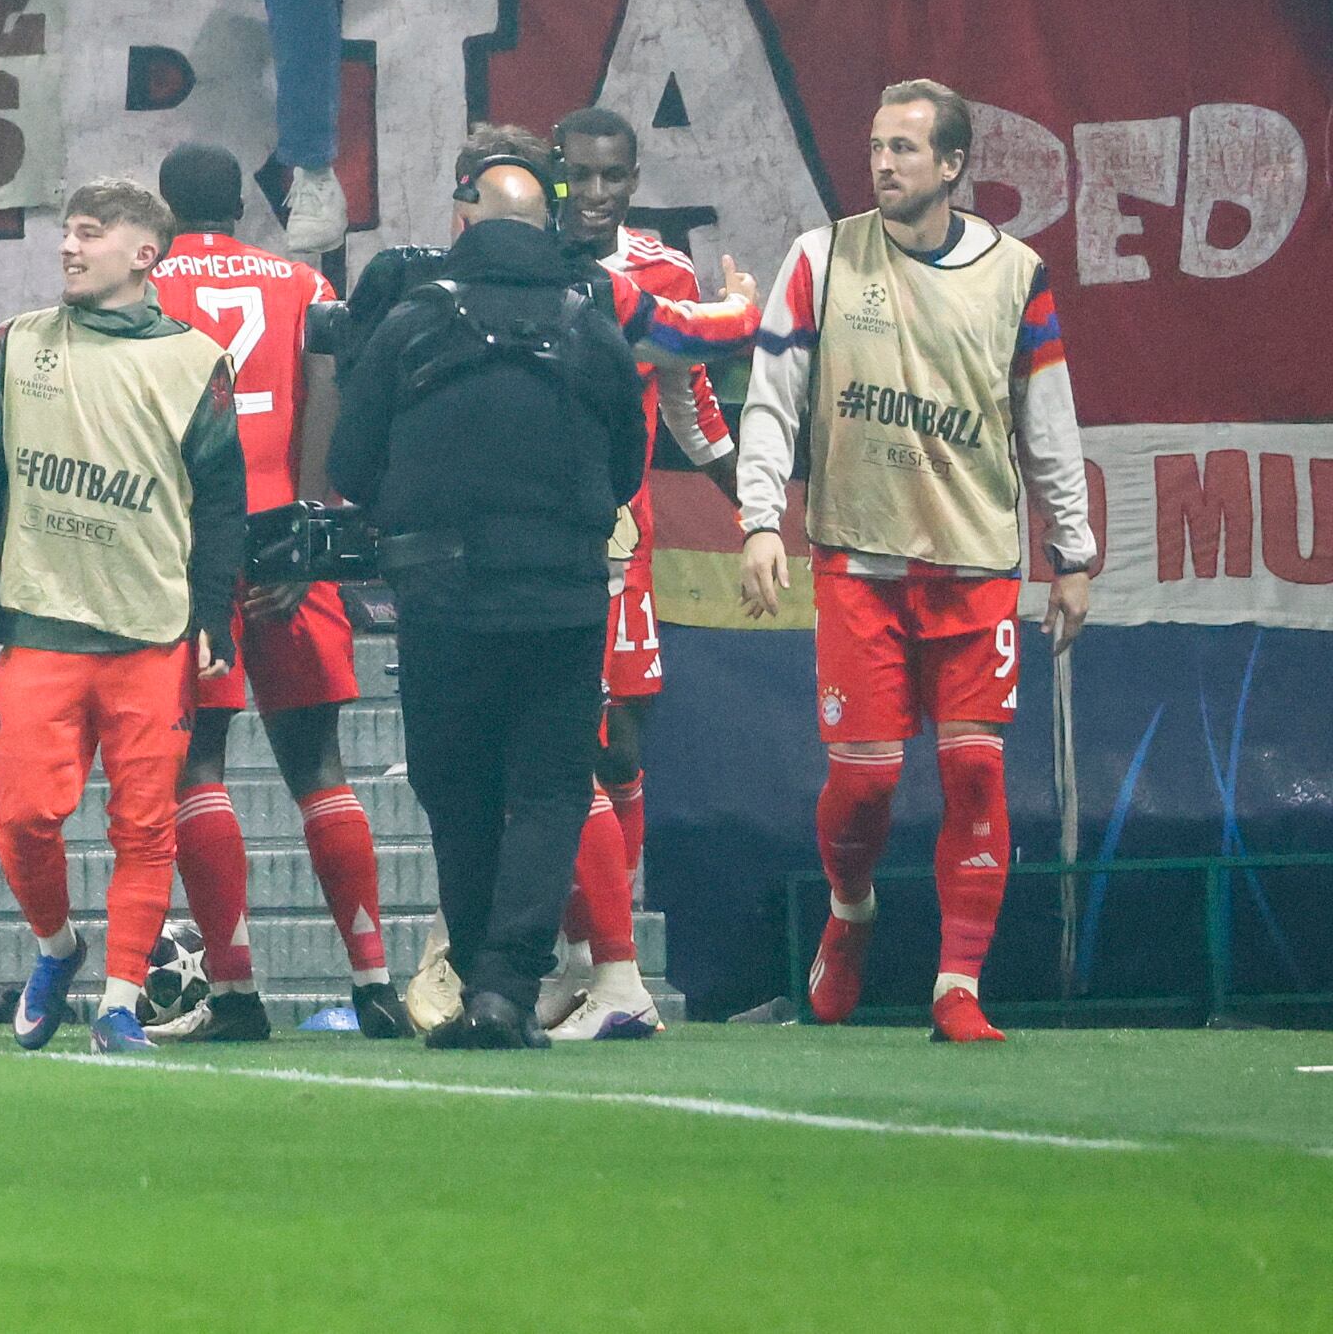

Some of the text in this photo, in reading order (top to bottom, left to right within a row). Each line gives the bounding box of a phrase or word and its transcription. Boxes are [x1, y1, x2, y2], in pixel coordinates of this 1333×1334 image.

[195, 285, 274, 416] 2
[14, 377, 65, 395] CHAMPIONS
[837, 380, 983, 449] #FOOTBALL
[16, 447, 158, 514] #FOOTBALL
[46, 513, 117, 542] RESPECT
[614, 591, 659, 651] 11
[994, 619, 1016, 678] 9
